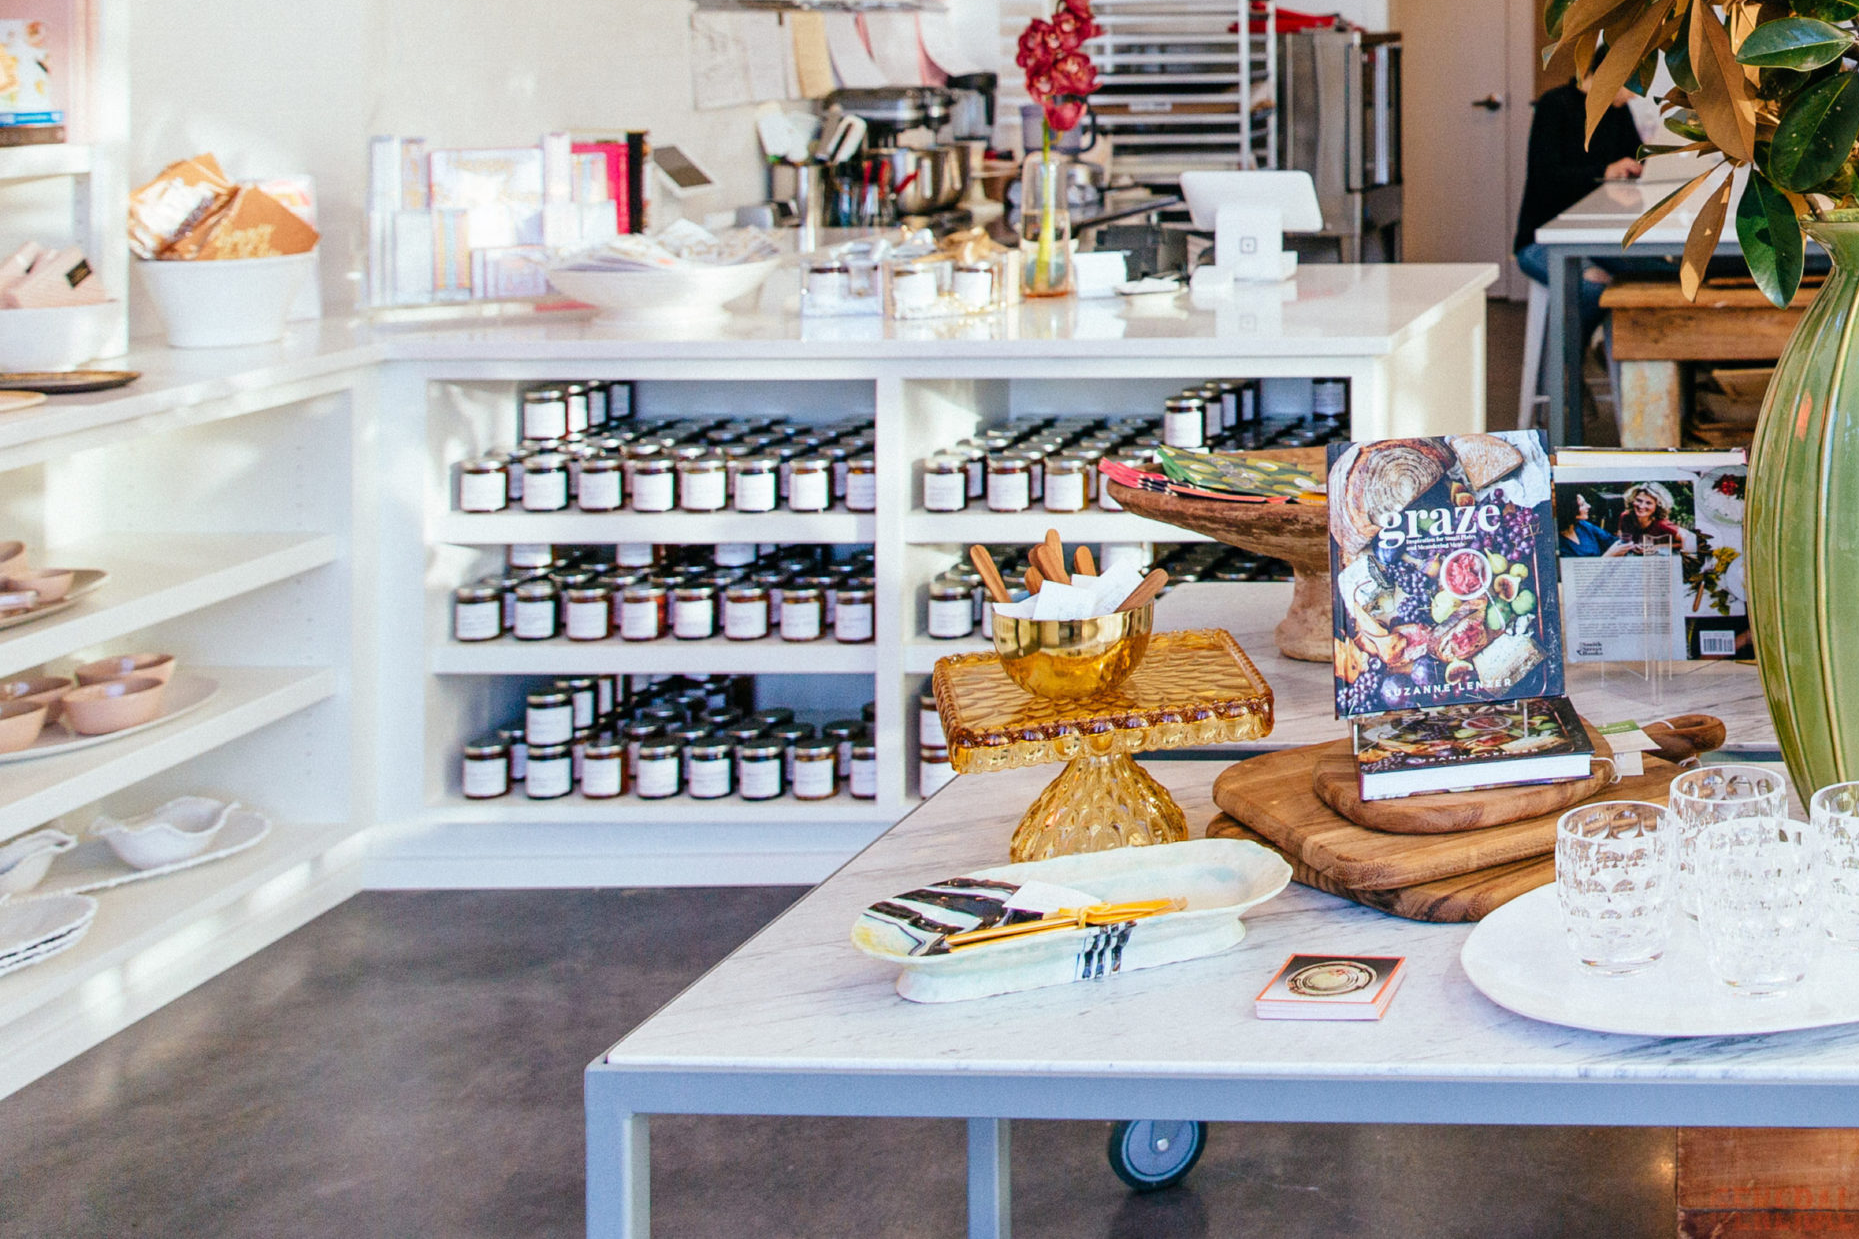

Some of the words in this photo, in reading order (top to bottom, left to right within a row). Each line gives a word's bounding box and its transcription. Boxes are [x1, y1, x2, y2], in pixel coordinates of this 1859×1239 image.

[1378, 504, 1501, 549] graze
[1385, 683, 1451, 697] SUZANNE
[1458, 677, 1512, 691] LENZER
